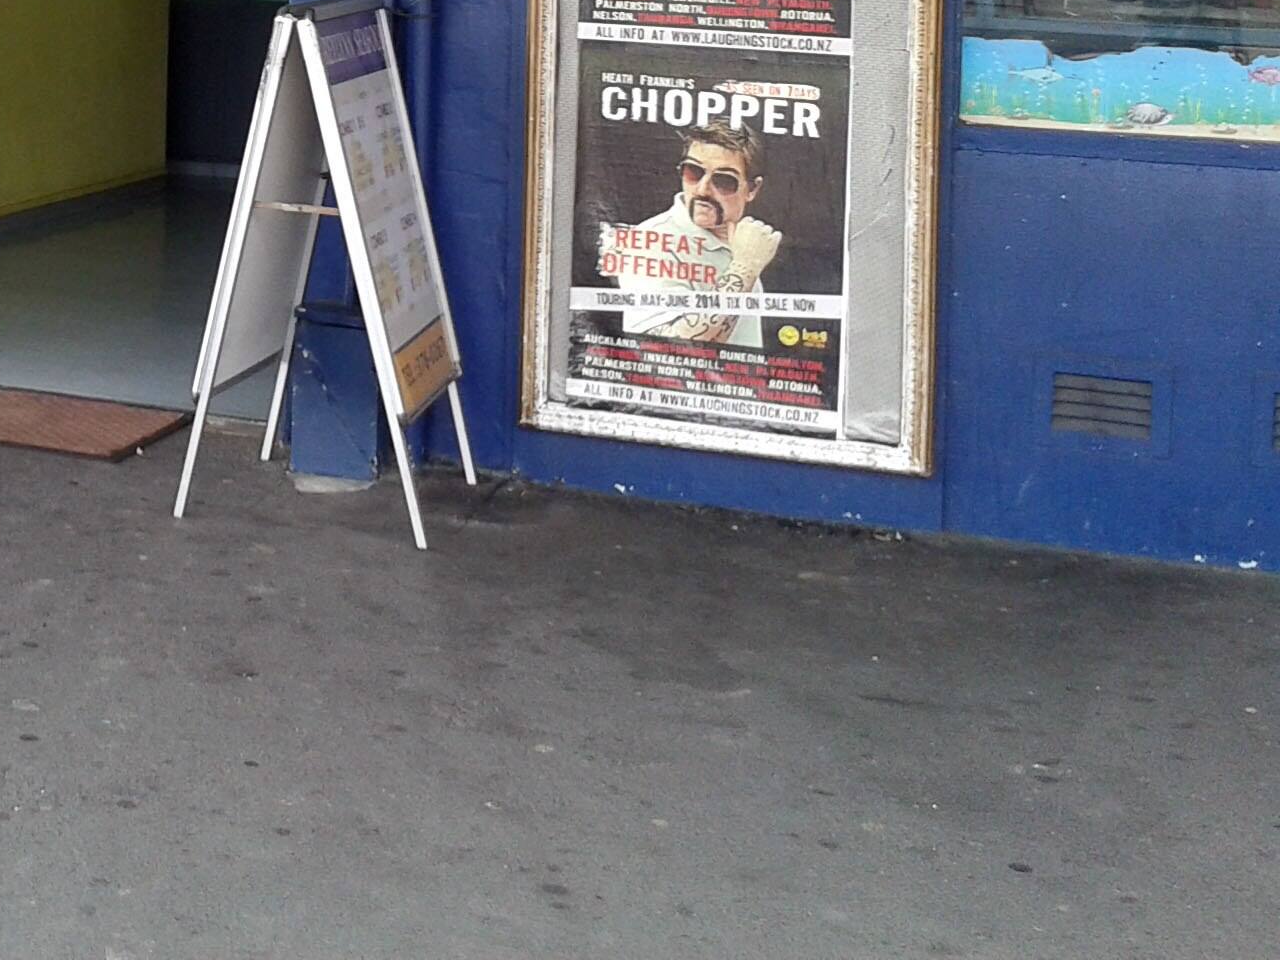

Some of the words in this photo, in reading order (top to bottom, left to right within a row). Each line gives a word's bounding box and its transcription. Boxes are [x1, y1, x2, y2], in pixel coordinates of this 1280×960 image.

[596, 26, 614, 38] ALL
[620, 28, 644, 41] INFO
[651, 30, 665, 41] AT
[602, 72, 633, 84] HEATH
[602, 87, 820, 138] CHOPPER
[615, 228, 705, 256] REPEAT
[602, 253, 717, 284] OFFENDER
[597, 292, 635, 305] TOURING
[695, 294, 720, 309] 2014
[746, 296, 759, 310] ON
[765, 297, 787, 311] SALE
[793, 298, 816, 312] NOW
[584, 383, 602, 396] ALL
[609, 386, 633, 400] INFO
[640, 389, 653, 402] AT
